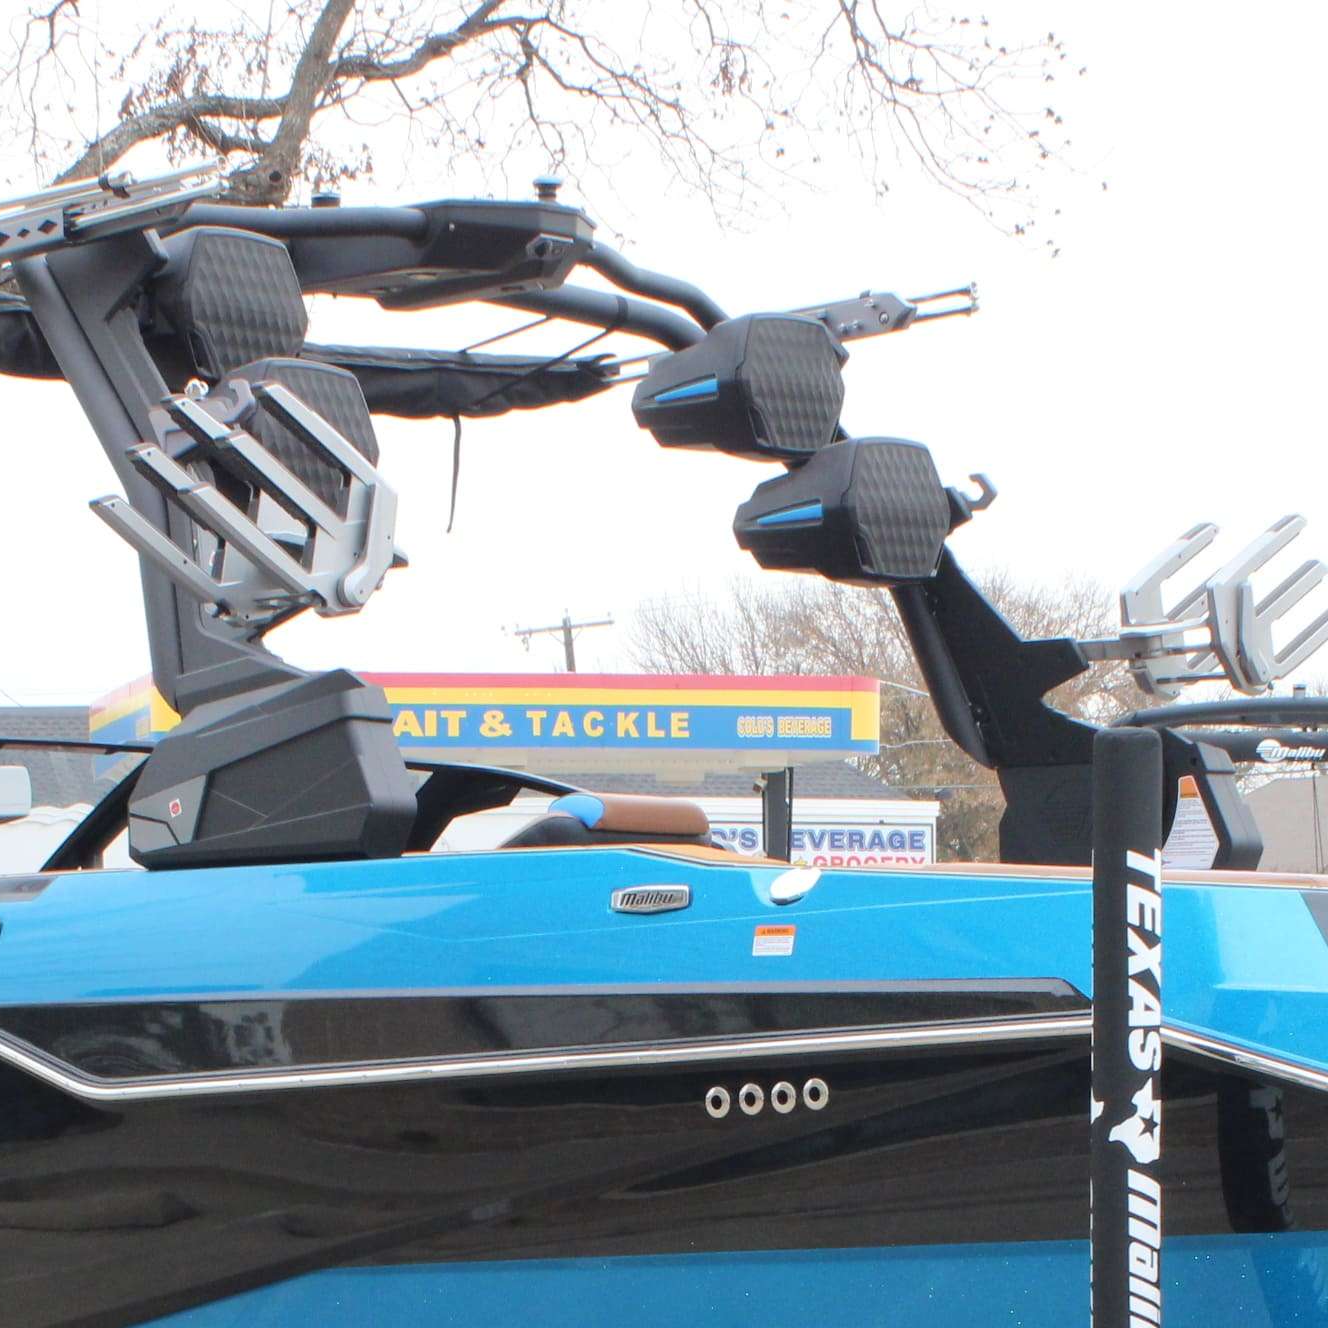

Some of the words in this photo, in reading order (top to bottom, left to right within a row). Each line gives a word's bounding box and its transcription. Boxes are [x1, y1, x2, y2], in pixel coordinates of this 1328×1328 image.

[393, 710, 467, 737] AIT
[479, 710, 512, 738] &
[527, 710, 690, 738] TACKLE
[791, 829, 926, 850] EVERAGE
[619, 891, 674, 906] Malibu
[1127, 848, 1162, 1072] TEXAS
